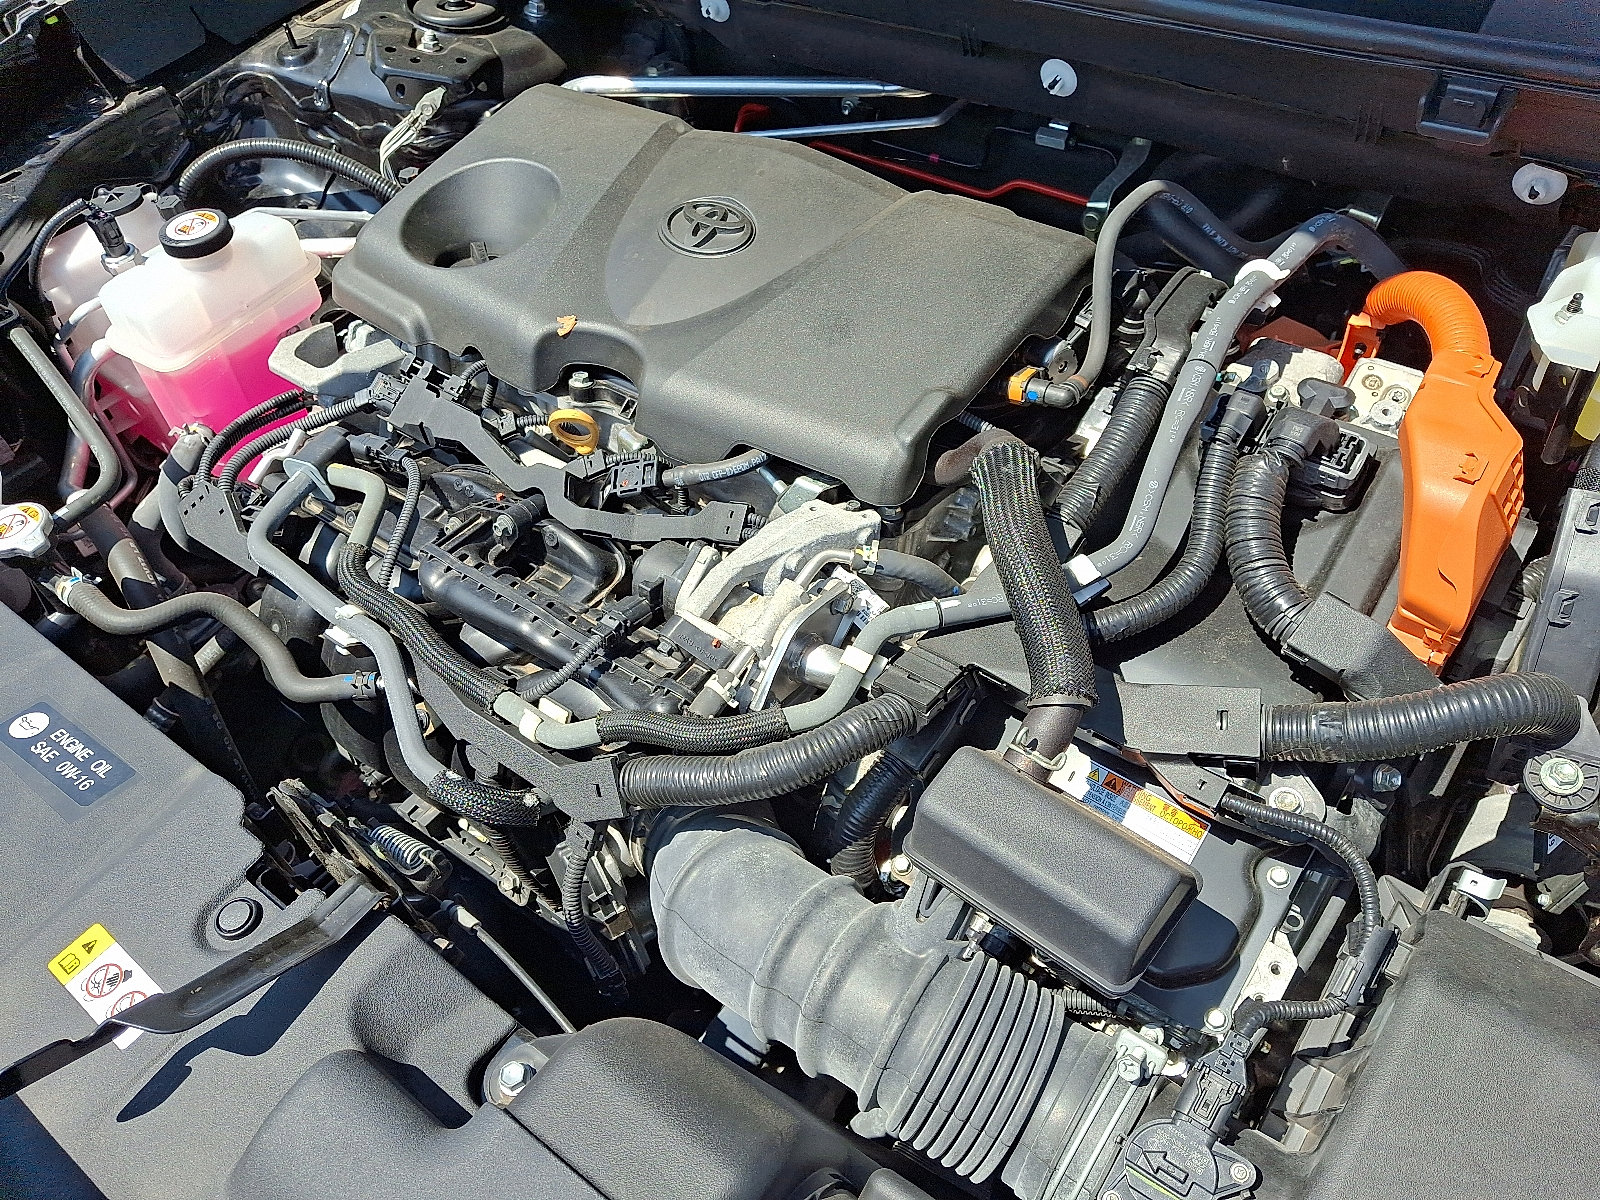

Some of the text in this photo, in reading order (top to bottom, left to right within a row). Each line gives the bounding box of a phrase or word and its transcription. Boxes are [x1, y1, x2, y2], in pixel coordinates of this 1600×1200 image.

[30, 741, 95, 791] SAE 0W-16
[50, 728, 112, 779] ENGINE OIL
